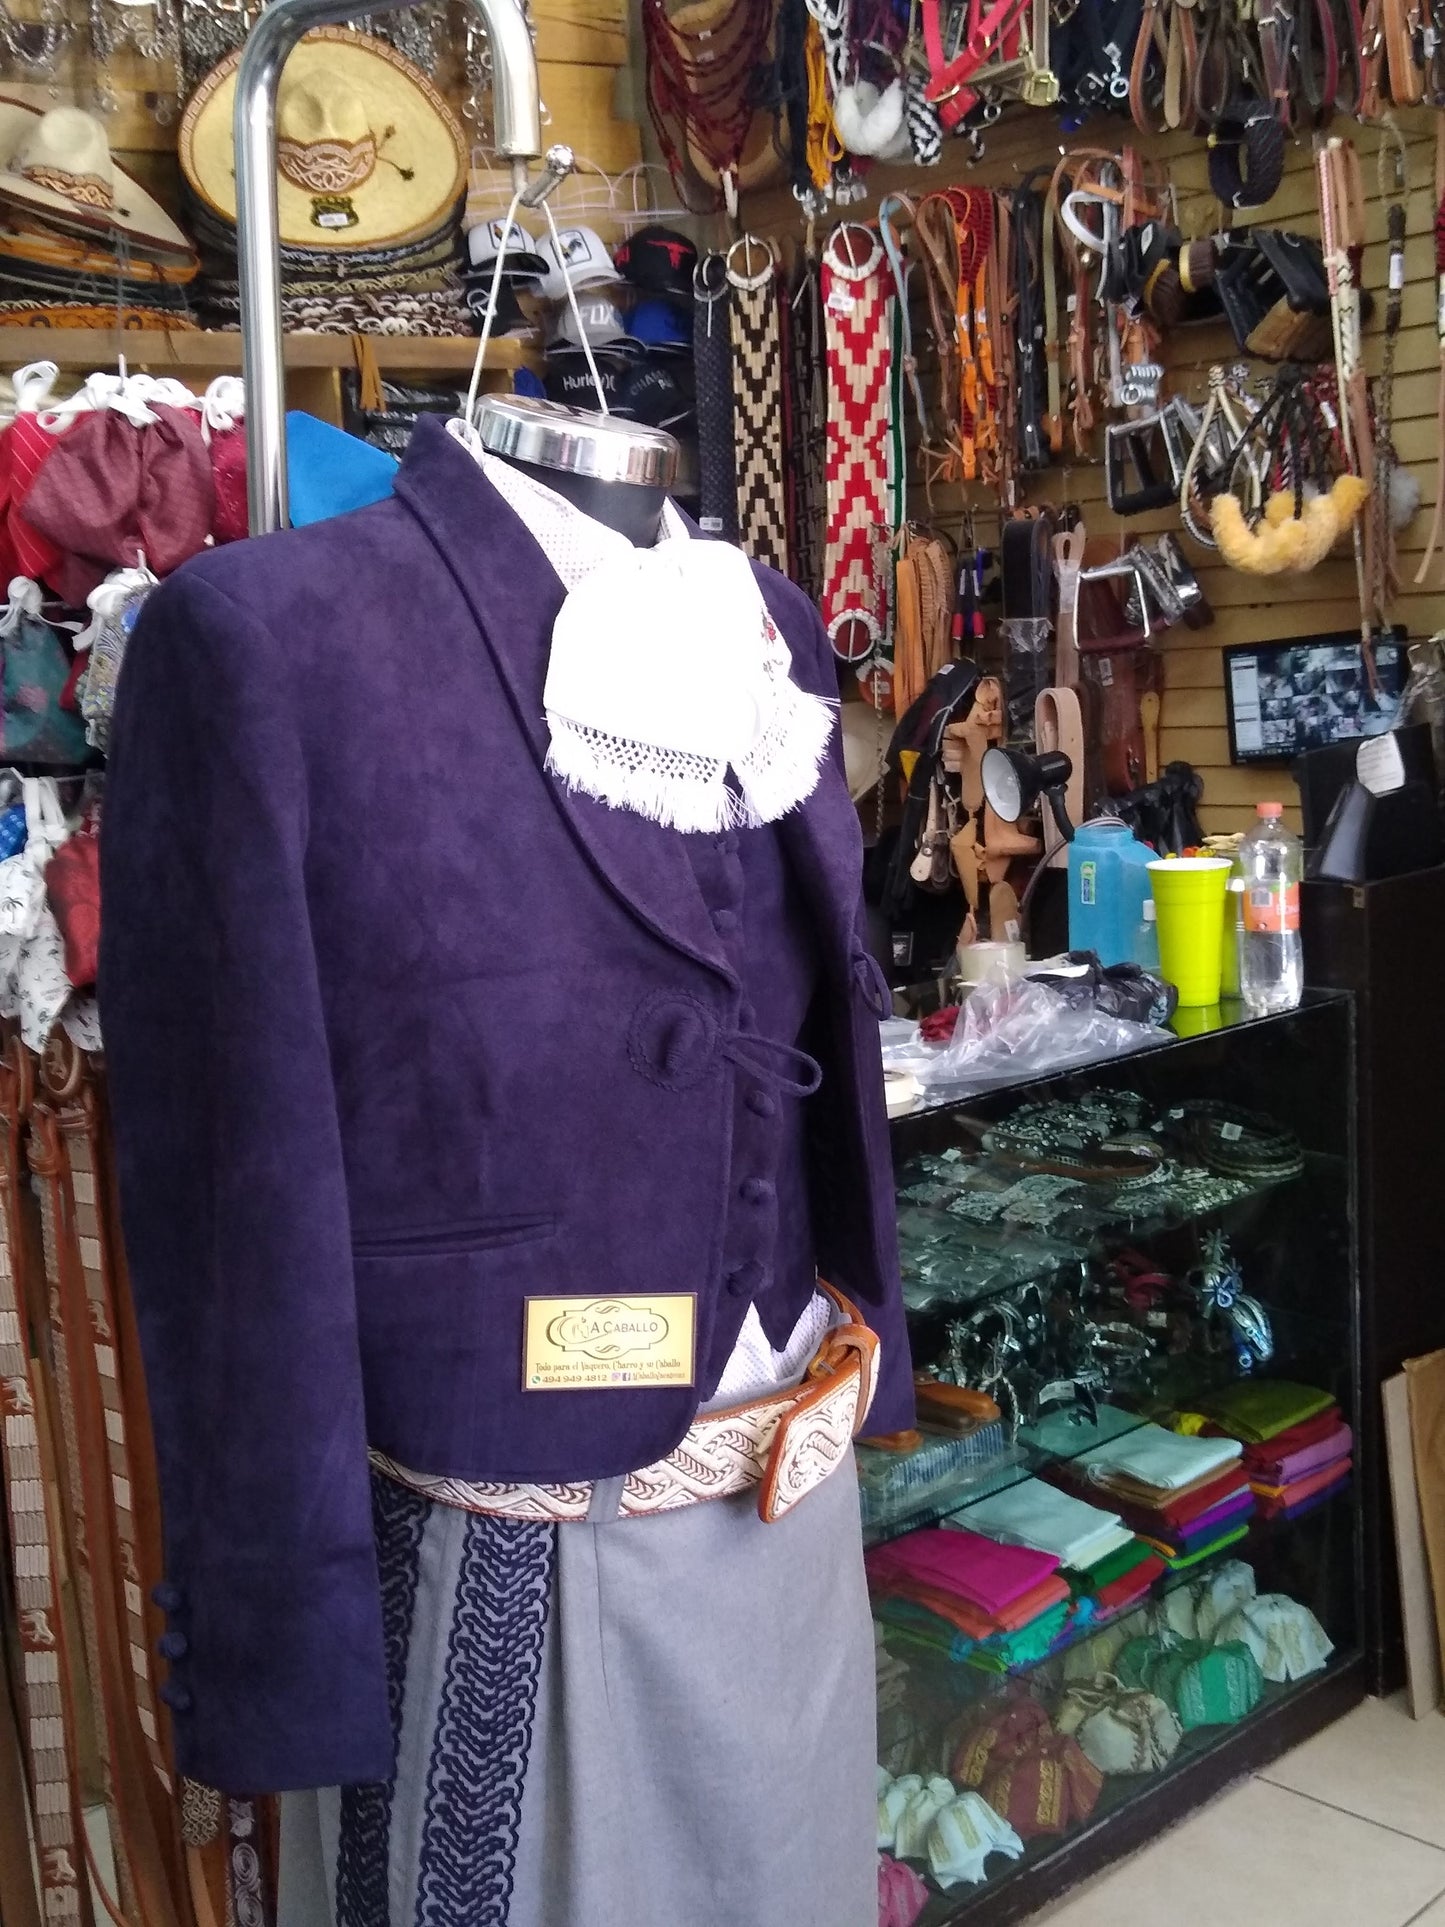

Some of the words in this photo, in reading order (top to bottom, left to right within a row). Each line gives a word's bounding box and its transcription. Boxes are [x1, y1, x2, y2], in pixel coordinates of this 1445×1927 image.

[579, 304, 614, 325] FOX
[590, 1321, 600, 1334] A
[535, 1362, 551, 1373] Todo
[553, 1363, 570, 1373] para
[572, 1361, 579, 1371] el
[612, 1360, 638, 1371] Charro
[639, 1362, 644, 1371] y
[655, 1358, 681, 1370] Caballo
[542, 1375, 561, 1383] 494
[563, 1375, 582, 1383] 949
[585, 1374, 607, 1382] 4812
